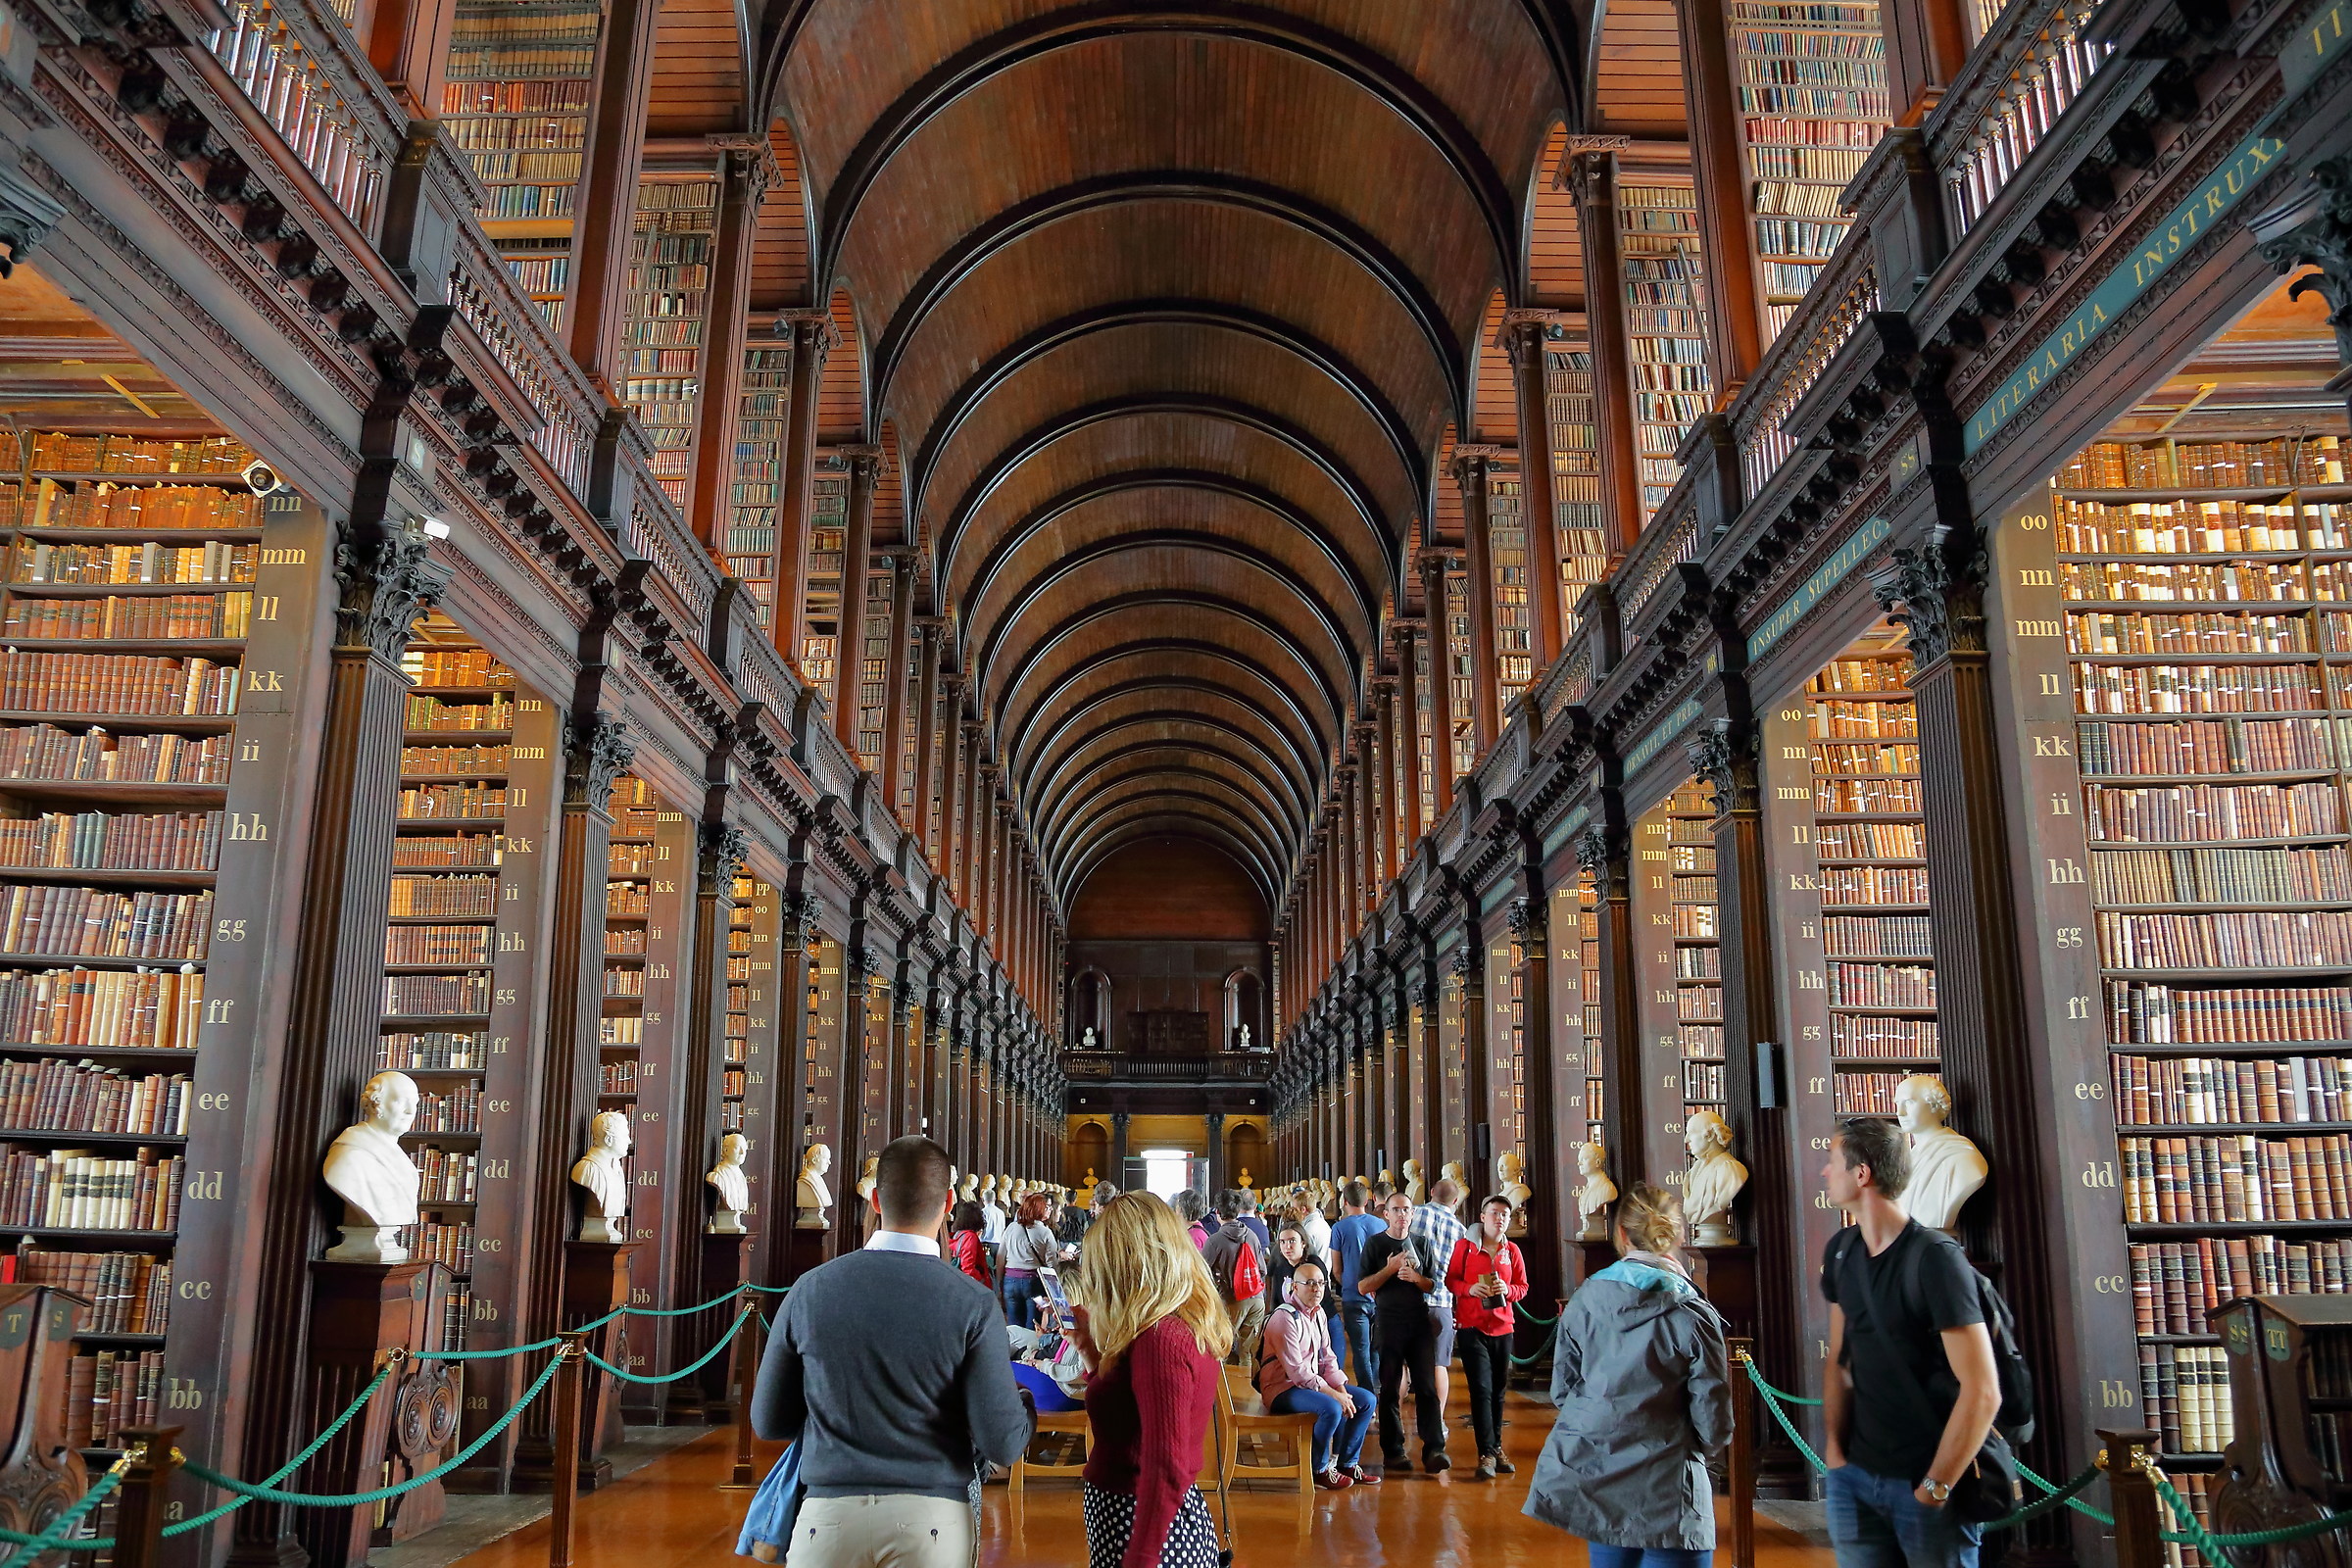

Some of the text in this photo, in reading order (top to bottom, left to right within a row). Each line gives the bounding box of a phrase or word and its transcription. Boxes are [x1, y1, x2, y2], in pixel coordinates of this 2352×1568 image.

[2306, 1, 2344, 55] TT
[1978, 135, 2286, 440] LITERARIA INSTRUX
[412, 442, 423, 464] S
[1898, 441, 1916, 476] SS
[271, 494, 302, 513] nn
[2020, 514, 2047, 532] oo
[262, 545, 306, 565] mm
[2020, 565, 2054, 587] nn
[1752, 520, 1890, 656] INSUPER SUPELLEC
[258, 596, 278, 621] ll
[2016, 616, 2061, 638] mm
[248, 671, 283, 692] kk
[2039, 674, 2062, 696] ll
[518, 699, 542, 711] nn
[1781, 710, 1802, 721] oo
[1662, 720, 1672, 741] ET
[241, 740, 259, 761] ii
[514, 747, 545, 760] mm
[1783, 746, 1807, 760] nn
[2034, 737, 2071, 758] kk
[512, 789, 527, 808] ll
[1777, 786, 1810, 800] mm
[2050, 793, 2070, 816] ii
[658, 811, 682, 822] mm
[228, 813, 268, 841] hh
[1646, 824, 1665, 834] nn
[1792, 826, 1809, 844] ll
[507, 838, 533, 853] kk
[658, 846, 669, 860] ll
[1642, 851, 1667, 861] mm
[2049, 858, 2084, 885] hh
[655, 880, 675, 893] kk
[1652, 875, 1663, 889] ll
[1790, 875, 1818, 890] kk
[505, 884, 518, 901] ii
[756, 883, 770, 897] pp
[1559, 888, 1579, 898] mm
[755, 906, 767, 914] oo
[1567, 913, 1577, 926] ll
[1652, 914, 1671, 925] kk
[217, 919, 246, 942] gg
[652, 926, 662, 940] ii
[1801, 922, 1816, 939] ii
[2056, 924, 2083, 950] gg
[499, 932, 526, 952] hh
[754, 934, 768, 943] nn
[821, 940, 835, 949] nn
[1562, 950, 1579, 960] kk
[1657, 951, 1668, 963] ii
[649, 963, 670, 979] hh
[752, 960, 771, 970] mm
[820, 966, 839, 975] mm
[1499, 975, 1507, 985] ll
[1567, 979, 1577, 990] ii
[1798, 970, 1825, 990] hh
[496, 989, 516, 1005] gg
[752, 989, 761, 1002] ll
[821, 990, 830, 1001] ll
[1655, 991, 1676, 1004] hh
[207, 999, 234, 1025] ff
[1496, 1004, 1510, 1013] kk
[2067, 996, 2089, 1020] ff
[646, 1012, 662, 1025] gg
[750, 1017, 766, 1028] kk
[820, 1016, 835, 1026] kk
[1565, 1015, 1582, 1026] hh
[1500, 1031, 1508, 1040] ii
[1802, 1022, 1821, 1040] gg
[493, 1037, 510, 1054] ff
[750, 1043, 760, 1054] ii
[819, 1042, 827, 1051] ii
[1659, 1035, 1674, 1048] gg
[1496, 1058, 1510, 1069] hh
[1565, 1053, 1579, 1062] gg
[643, 1063, 657, 1076] ff
[748, 1069, 763, 1084] hh
[817, 1066, 832, 1077] hh
[1662, 1075, 1676, 1088] ff
[1808, 1077, 1826, 1095] ff
[1499, 1090, 1509, 1099] gg
[2075, 1079, 2105, 1101] ee
[198, 1093, 229, 1111] ee
[488, 1100, 511, 1112] ee
[817, 1095, 828, 1104] gg
[1570, 1096, 1582, 1106] ff
[642, 1111, 660, 1122] ee
[747, 1105, 760, 1117] gg
[1501, 1118, 1510, 1127] ff
[1664, 1122, 1682, 1134] ee
[815, 1125, 826, 1135] ff
[1810, 1137, 1832, 1151] ee
[484, 1159, 510, 1179] dd
[2082, 1162, 2116, 1190] dd
[638, 1171, 659, 1187] dd
[1665, 1171, 1684, 1186] dd
[188, 1172, 222, 1201] dd
[635, 1228, 654, 1240] cc
[479, 1239, 502, 1252] cc
[179, 1281, 212, 1300] cc
[2094, 1274, 2126, 1295] cc
[632, 1289, 651, 1304] bb
[473, 1299, 498, 1321] bb
[8, 1314, 23, 1333] T
[53, 1310, 64, 1328] S
[2230, 1324, 2248, 1344] SS
[2267, 1329, 2285, 1349] TT
[628, 1355, 646, 1366] aa
[170, 1379, 202, 1410] bb
[2101, 1380, 2134, 1409] bb
[467, 1396, 488, 1410] aa
